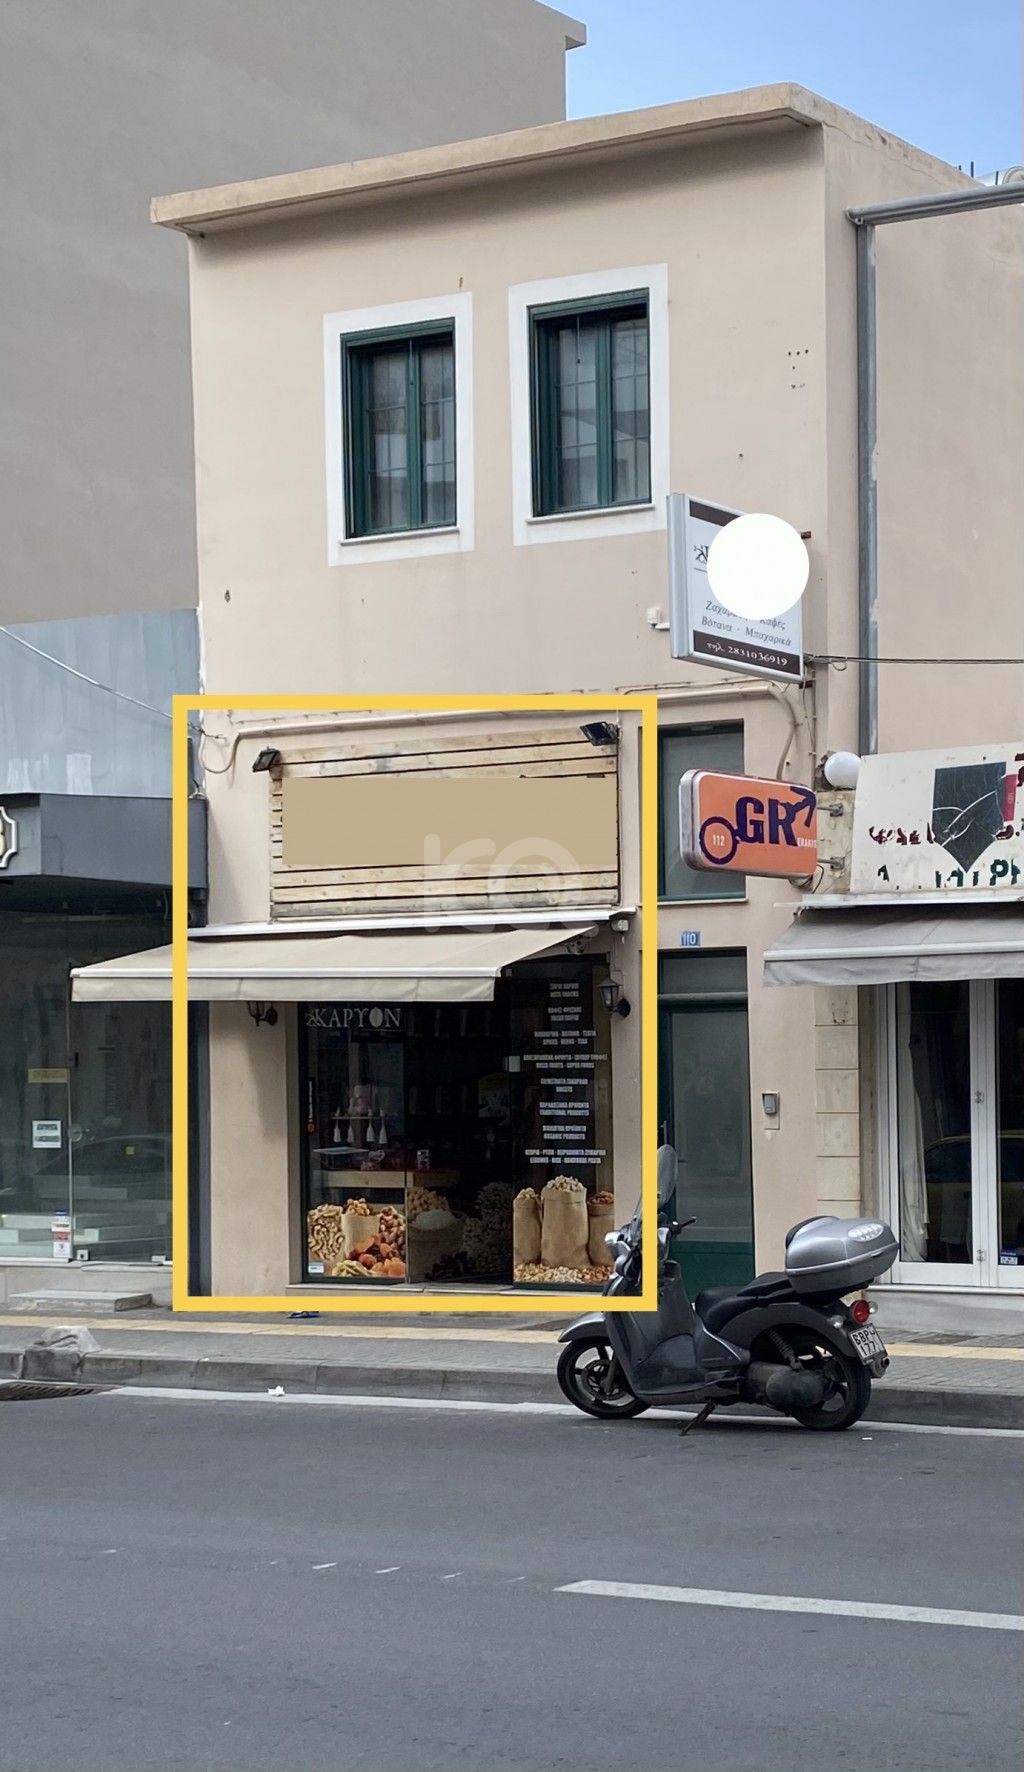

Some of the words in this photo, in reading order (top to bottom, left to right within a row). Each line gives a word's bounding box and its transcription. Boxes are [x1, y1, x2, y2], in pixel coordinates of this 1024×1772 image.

[701, 615, 733, 632] Βότανα
[728, 646, 788, 666] 2831036919
[712, 834, 726, 847] 112
[682, 932, 697, 946] 110
